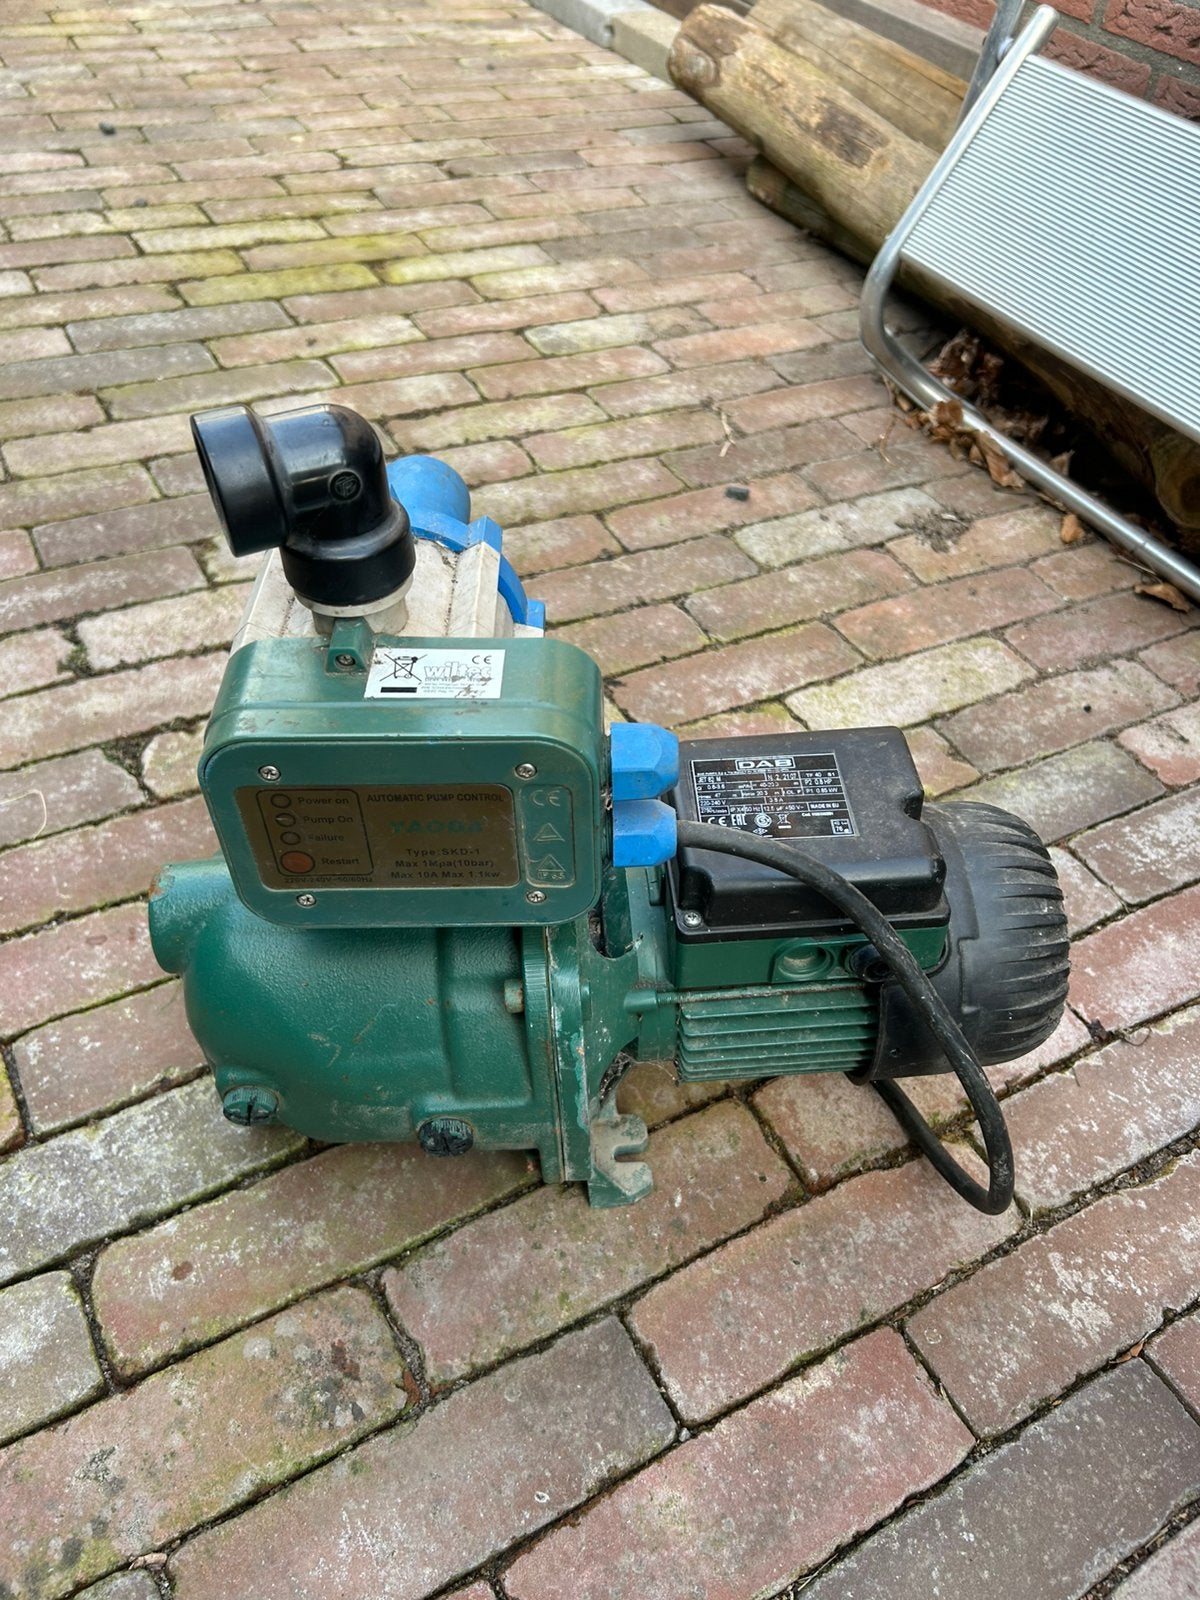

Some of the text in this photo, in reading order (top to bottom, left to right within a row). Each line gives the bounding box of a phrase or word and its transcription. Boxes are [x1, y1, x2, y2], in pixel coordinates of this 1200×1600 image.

[738, 760, 792, 769] DAB
[298, 796, 349, 805] Power on
[366, 793, 504, 803] AUTOMATIC PUMP CONTROL
[530, 788, 561, 807] CE
[303, 815, 354, 824] Pump On
[708, 817, 727, 826] CE
[307, 833, 345, 842] Failure
[320, 857, 360, 866] Restart
[395, 860, 418, 868] Max
[390, 871, 415, 879] Max
[418, 871, 439, 879] 10A
